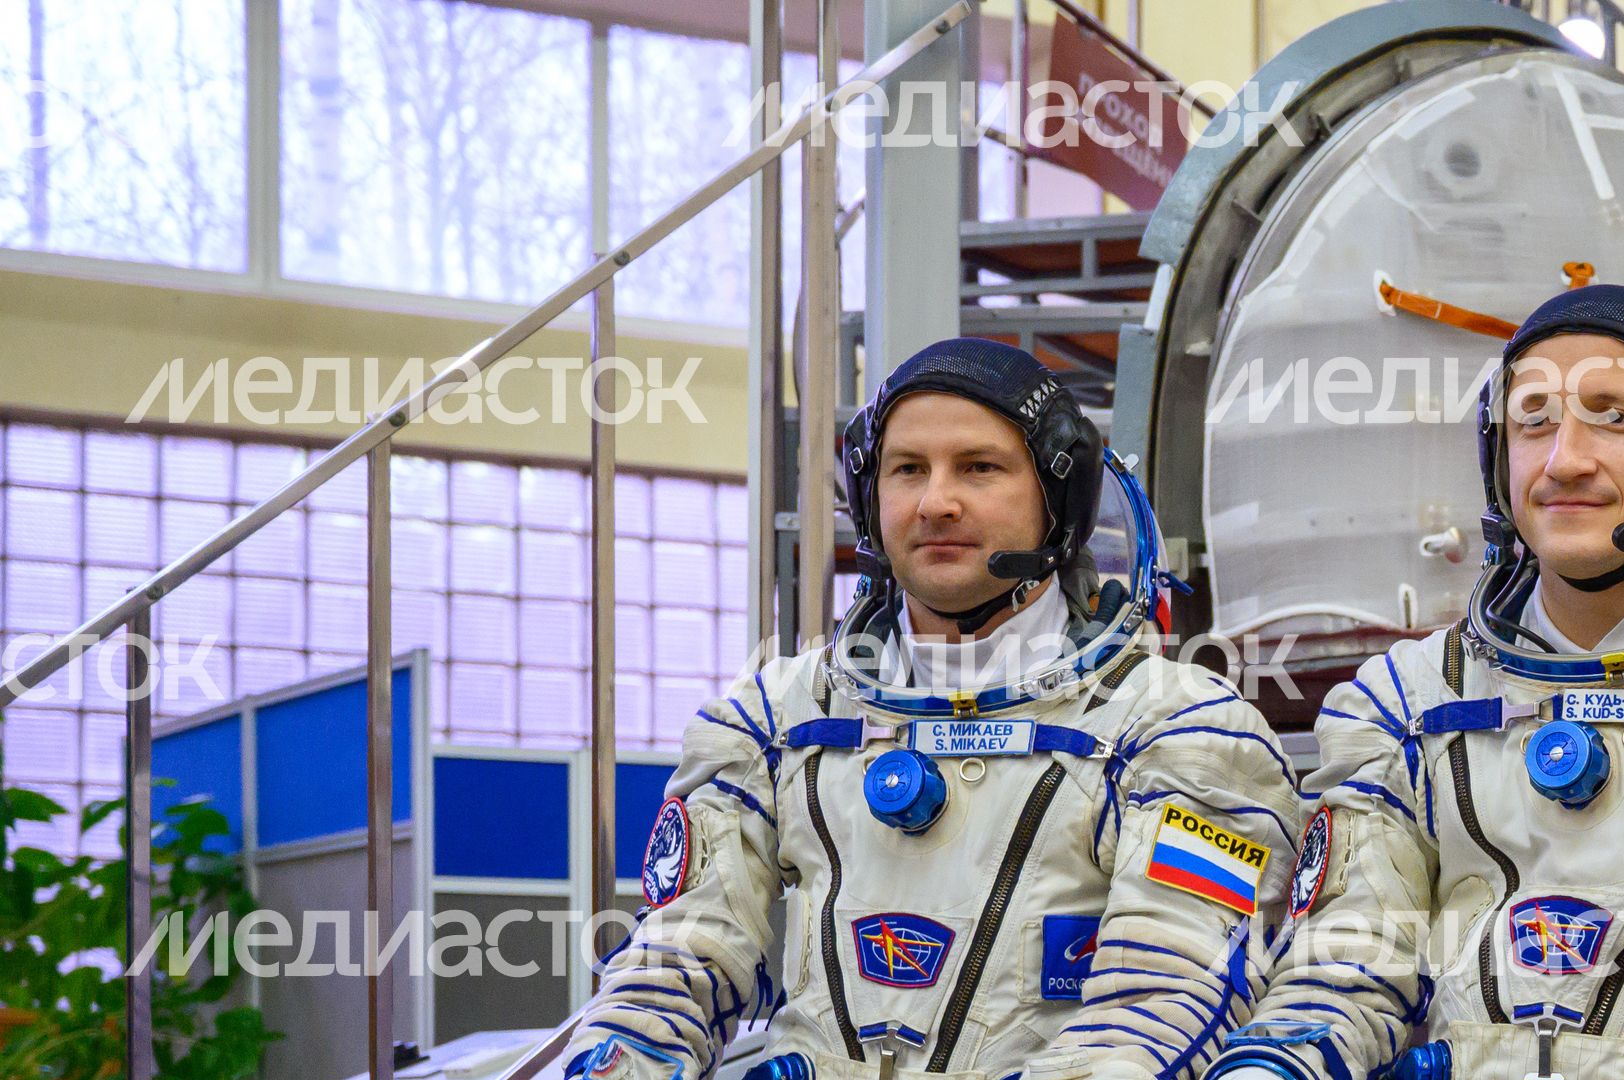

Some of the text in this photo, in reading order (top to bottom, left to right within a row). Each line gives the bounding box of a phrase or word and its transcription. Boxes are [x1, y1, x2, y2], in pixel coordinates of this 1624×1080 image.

[1566, 694, 1579, 706] С.
[1566, 707, 1578, 719] S.
[932, 723, 1013, 737] С. МИКАЕВ
[935, 738, 1008, 751] S. MIKAEV
[1164, 807, 1265, 868] РОССИЯ
